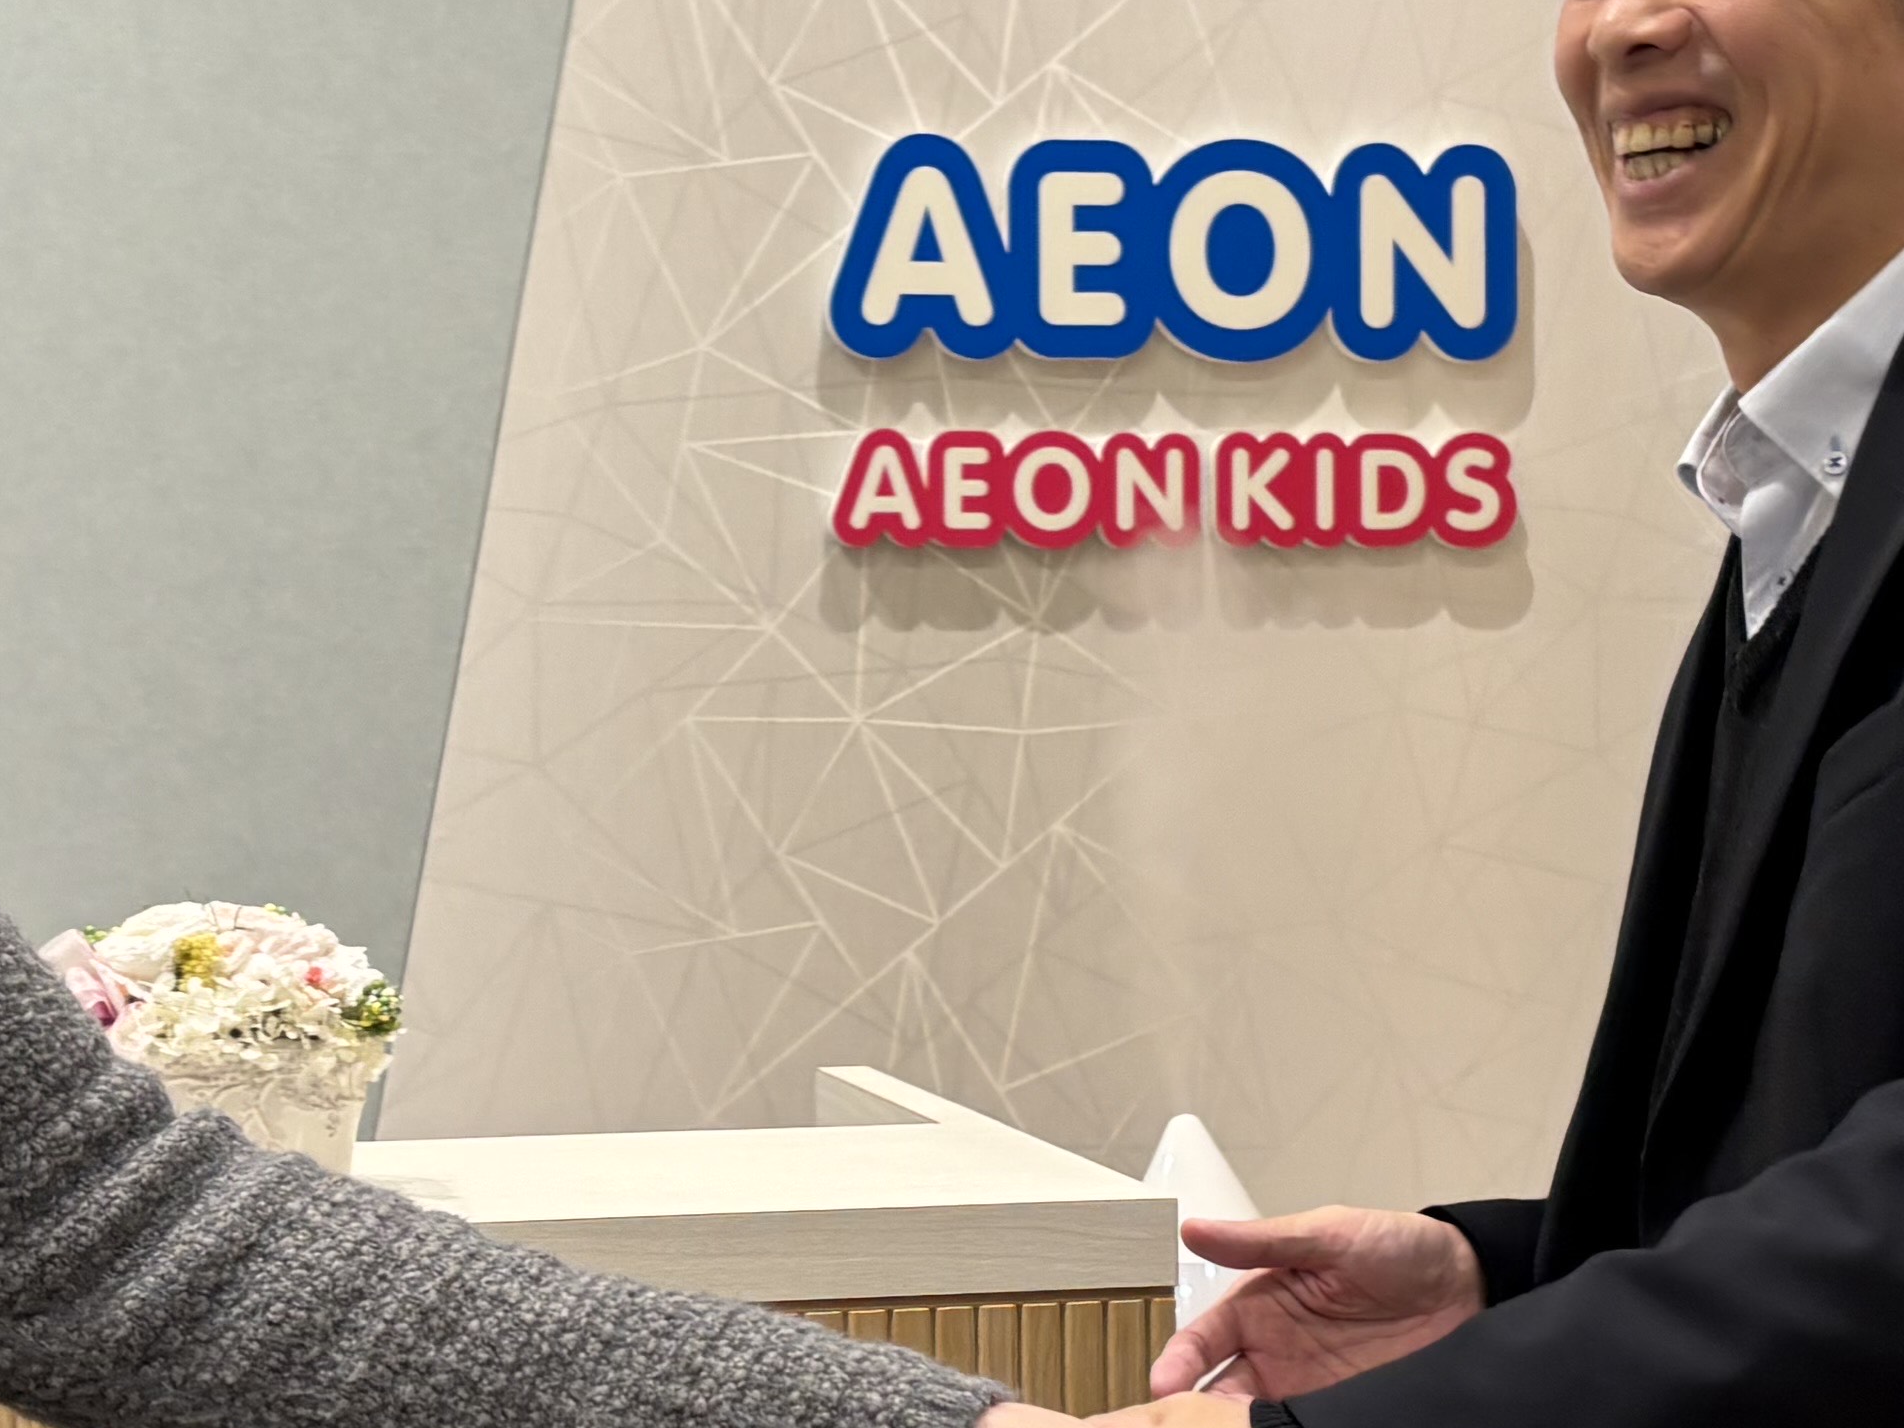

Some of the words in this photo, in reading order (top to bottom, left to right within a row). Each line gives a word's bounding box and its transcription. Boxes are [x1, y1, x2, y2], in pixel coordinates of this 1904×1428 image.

[831, 133, 1518, 362] AEON
[834, 428, 1201, 550] AEON
[1216, 432, 1517, 549] KIDS
